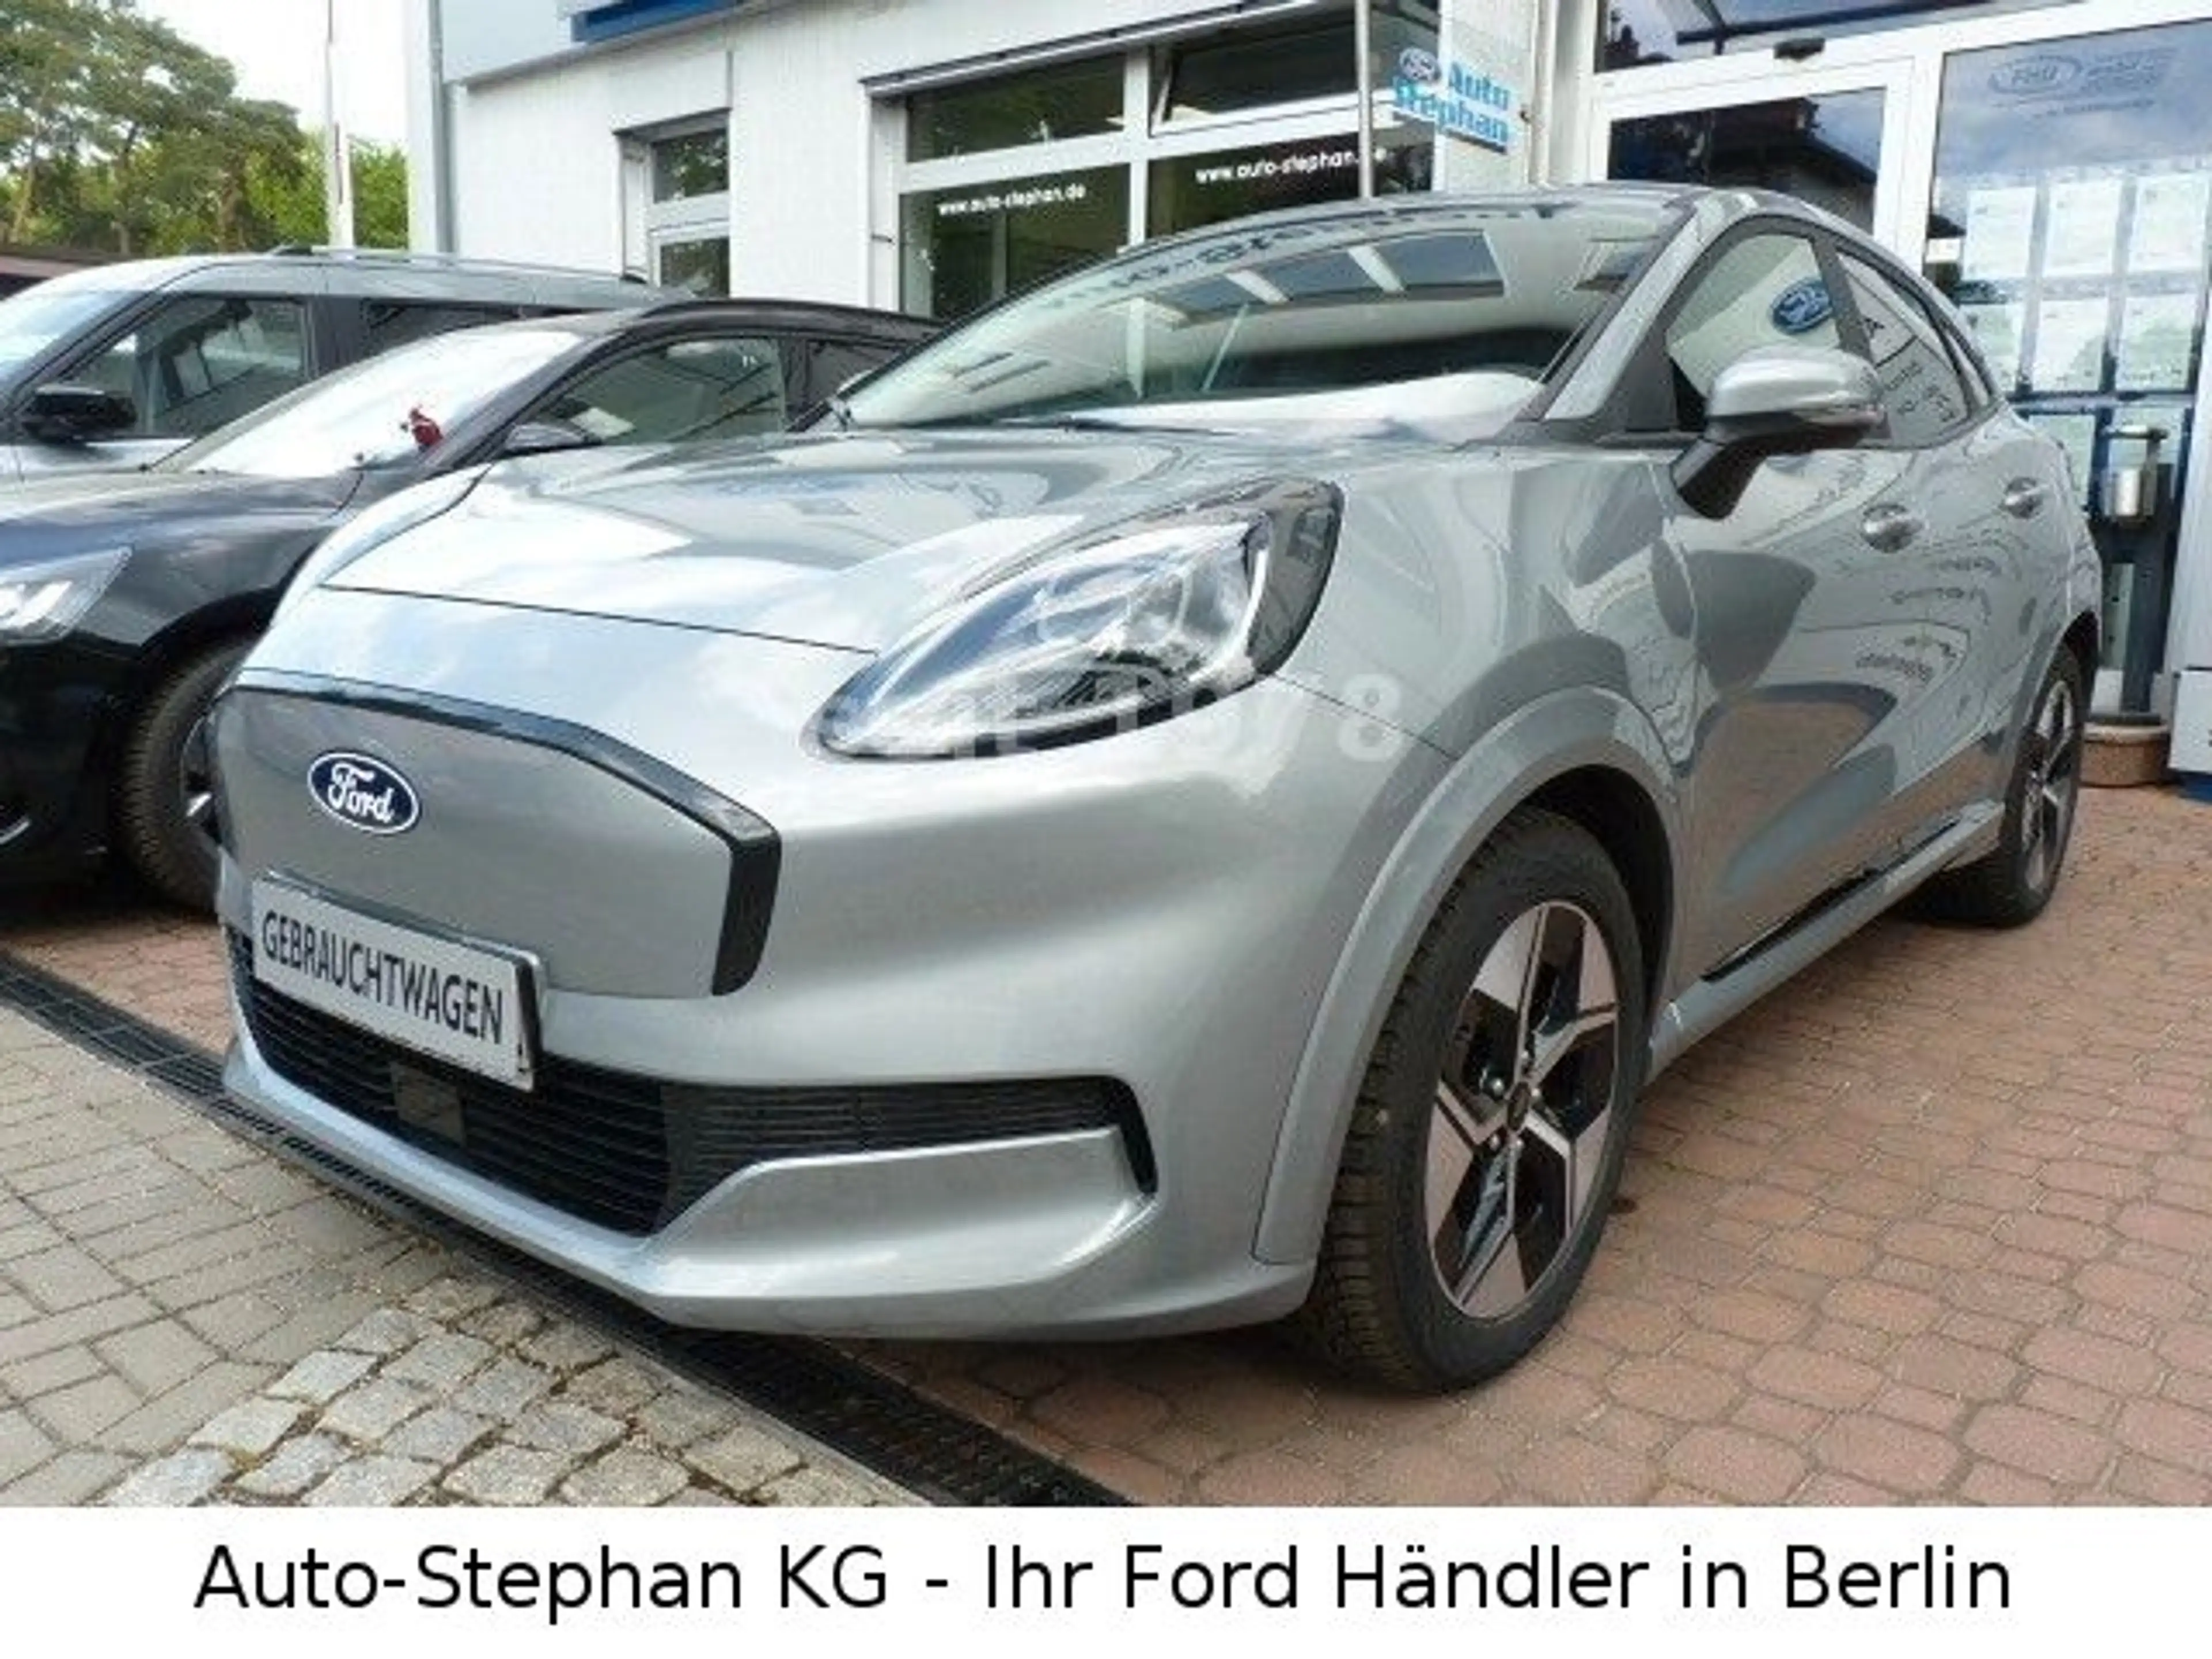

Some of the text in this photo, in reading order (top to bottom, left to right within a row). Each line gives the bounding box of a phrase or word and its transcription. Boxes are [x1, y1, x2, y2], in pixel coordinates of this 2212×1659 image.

[1449, 61, 1509, 111] Auto
[327, 763, 395, 824] Ford
[262, 910, 503, 1044] GEBRAUCHTWAGEN
